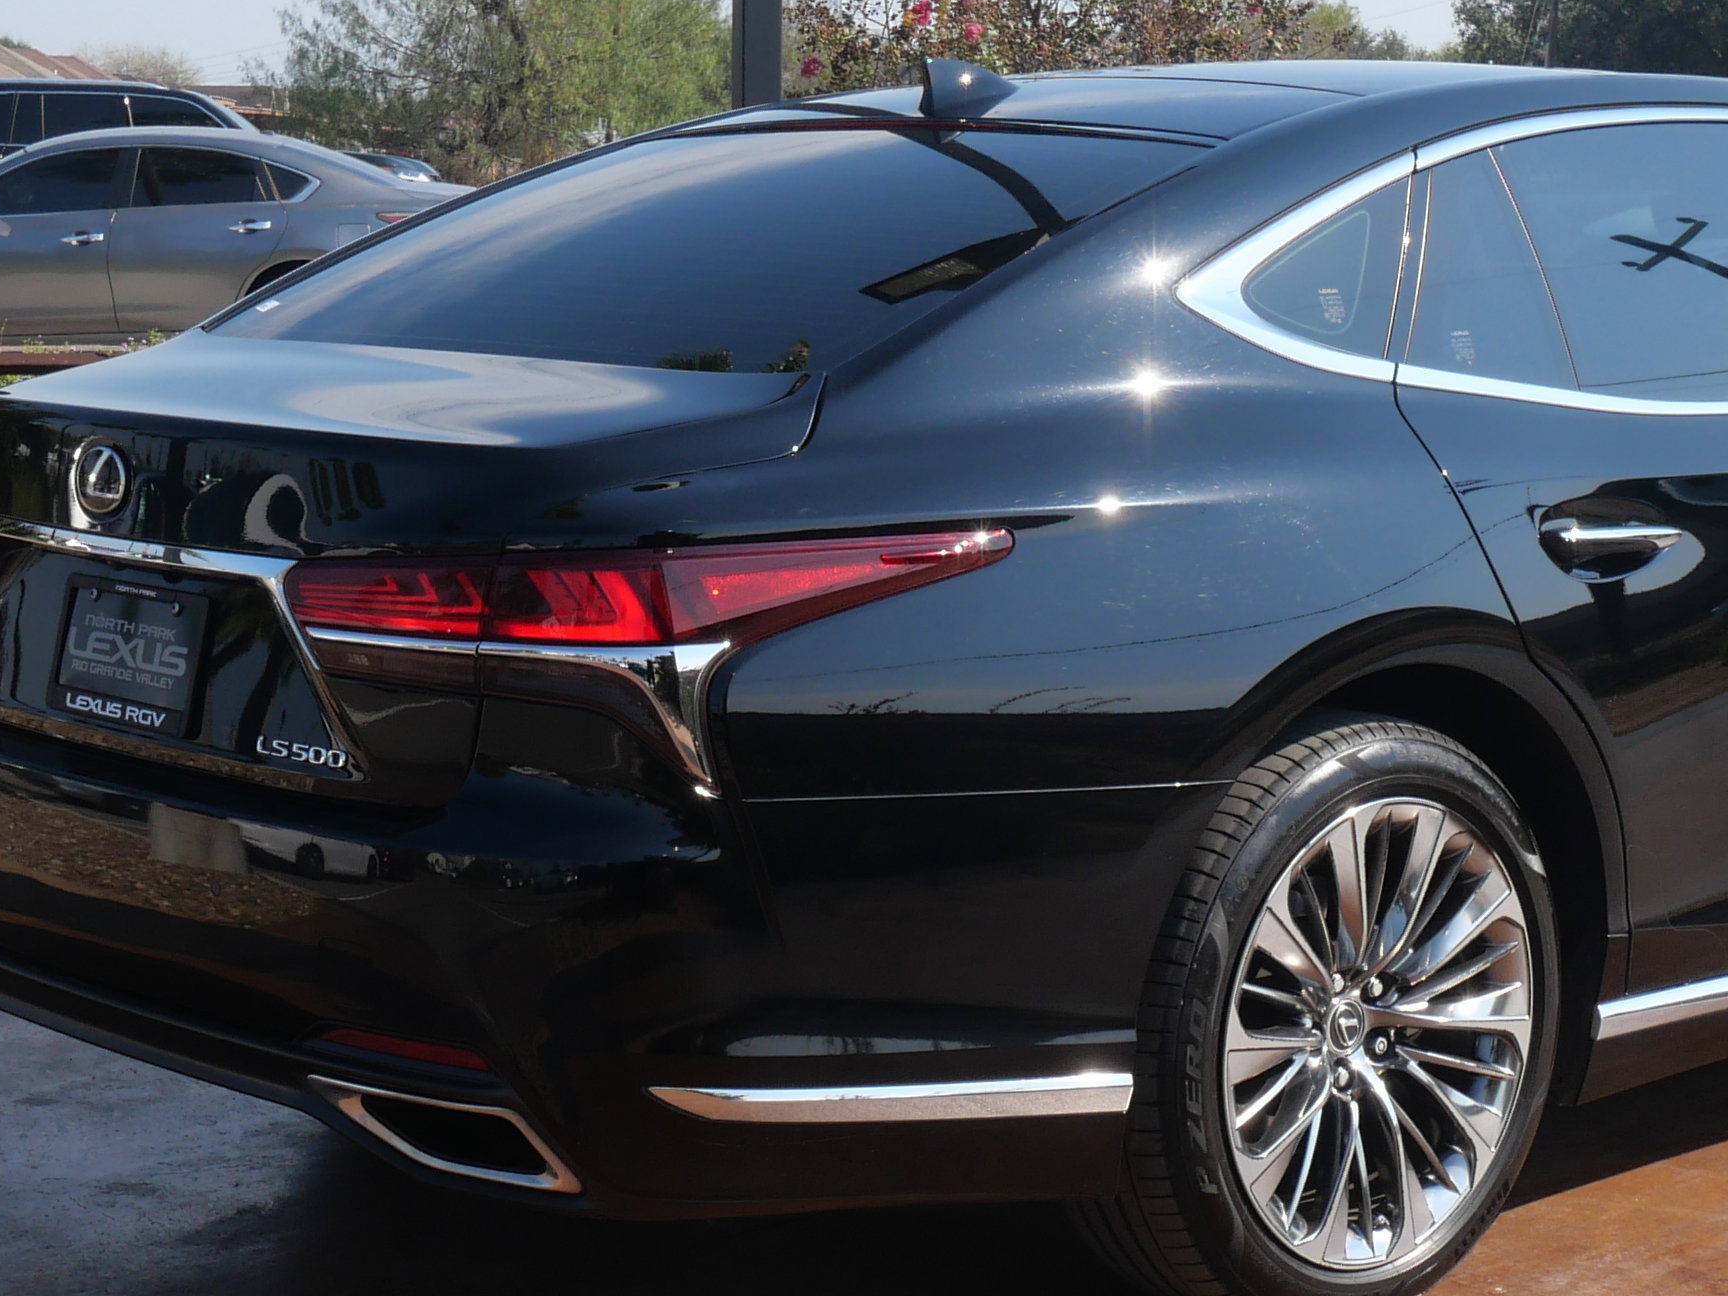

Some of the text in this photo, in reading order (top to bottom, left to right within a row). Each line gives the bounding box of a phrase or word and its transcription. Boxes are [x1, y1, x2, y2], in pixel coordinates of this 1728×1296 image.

[85, 612, 177, 642] NORTH PARK
[68, 626, 188, 677] LEXUS
[72, 658, 175, 689] RIO GRANDE VALLEY
[66, 692, 166, 727] LEXUS RGV
